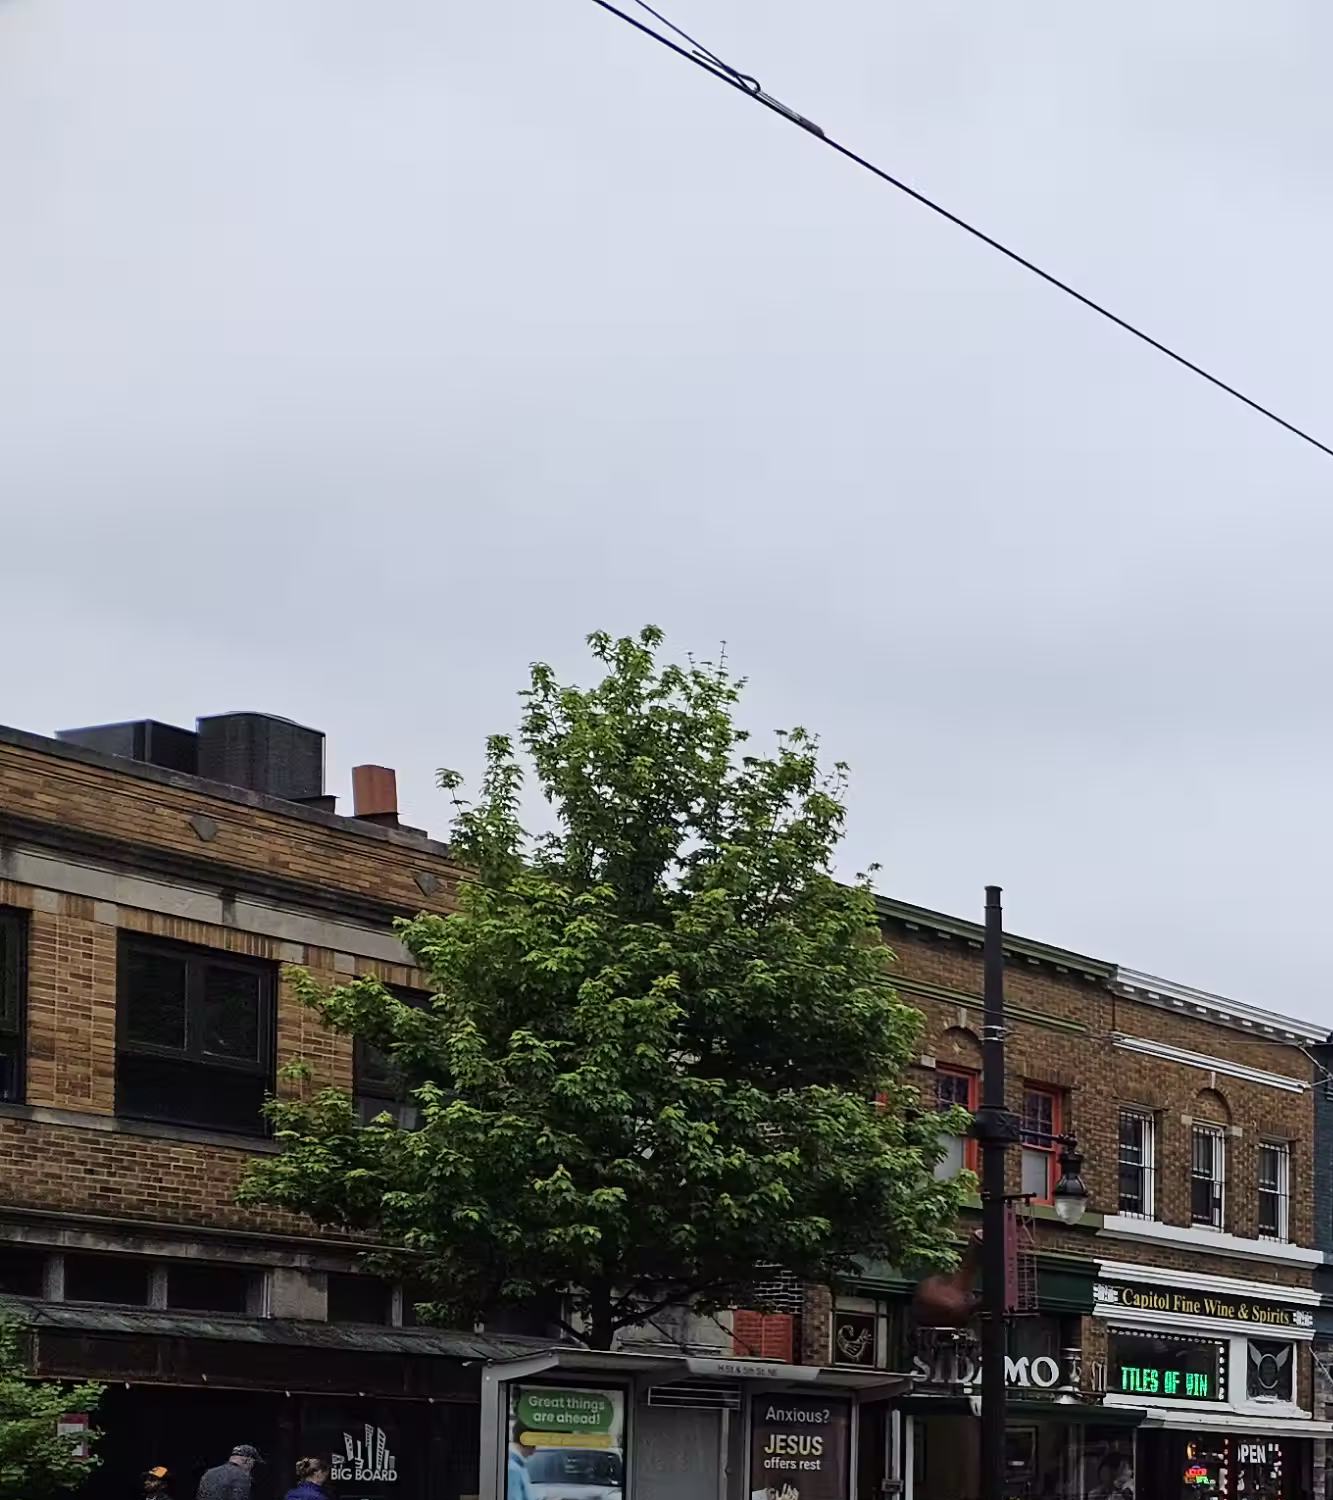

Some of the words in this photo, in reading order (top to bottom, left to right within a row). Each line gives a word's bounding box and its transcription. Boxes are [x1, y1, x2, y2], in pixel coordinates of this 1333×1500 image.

[1122, 1288, 1170, 1310] Capitol
[1174, 1294, 1201, 1314] Fine
[1203, 1297, 1235, 1319] Wine
[1237, 1304, 1249, 1320] &
[1251, 1307, 1290, 1325] Spirits
[913, 1356, 1060, 1387] SIDMO
[529, 1396, 564, 1408] Great
[566, 1397, 605, 1411] things
[533, 1413, 554, 1423] are
[556, 1412, 600, 1425] ahead!
[765, 1406, 830, 1424] Anxious?
[764, 1434, 823, 1456] JESUS
[1237, 1444, 1266, 1464] PEN
[764, 1458, 797, 1470] offers
[799, 1459, 821, 1470] rest
[331, 1468, 352, 1480] BIG
[355, 1469, 398, 1481] BOARD
